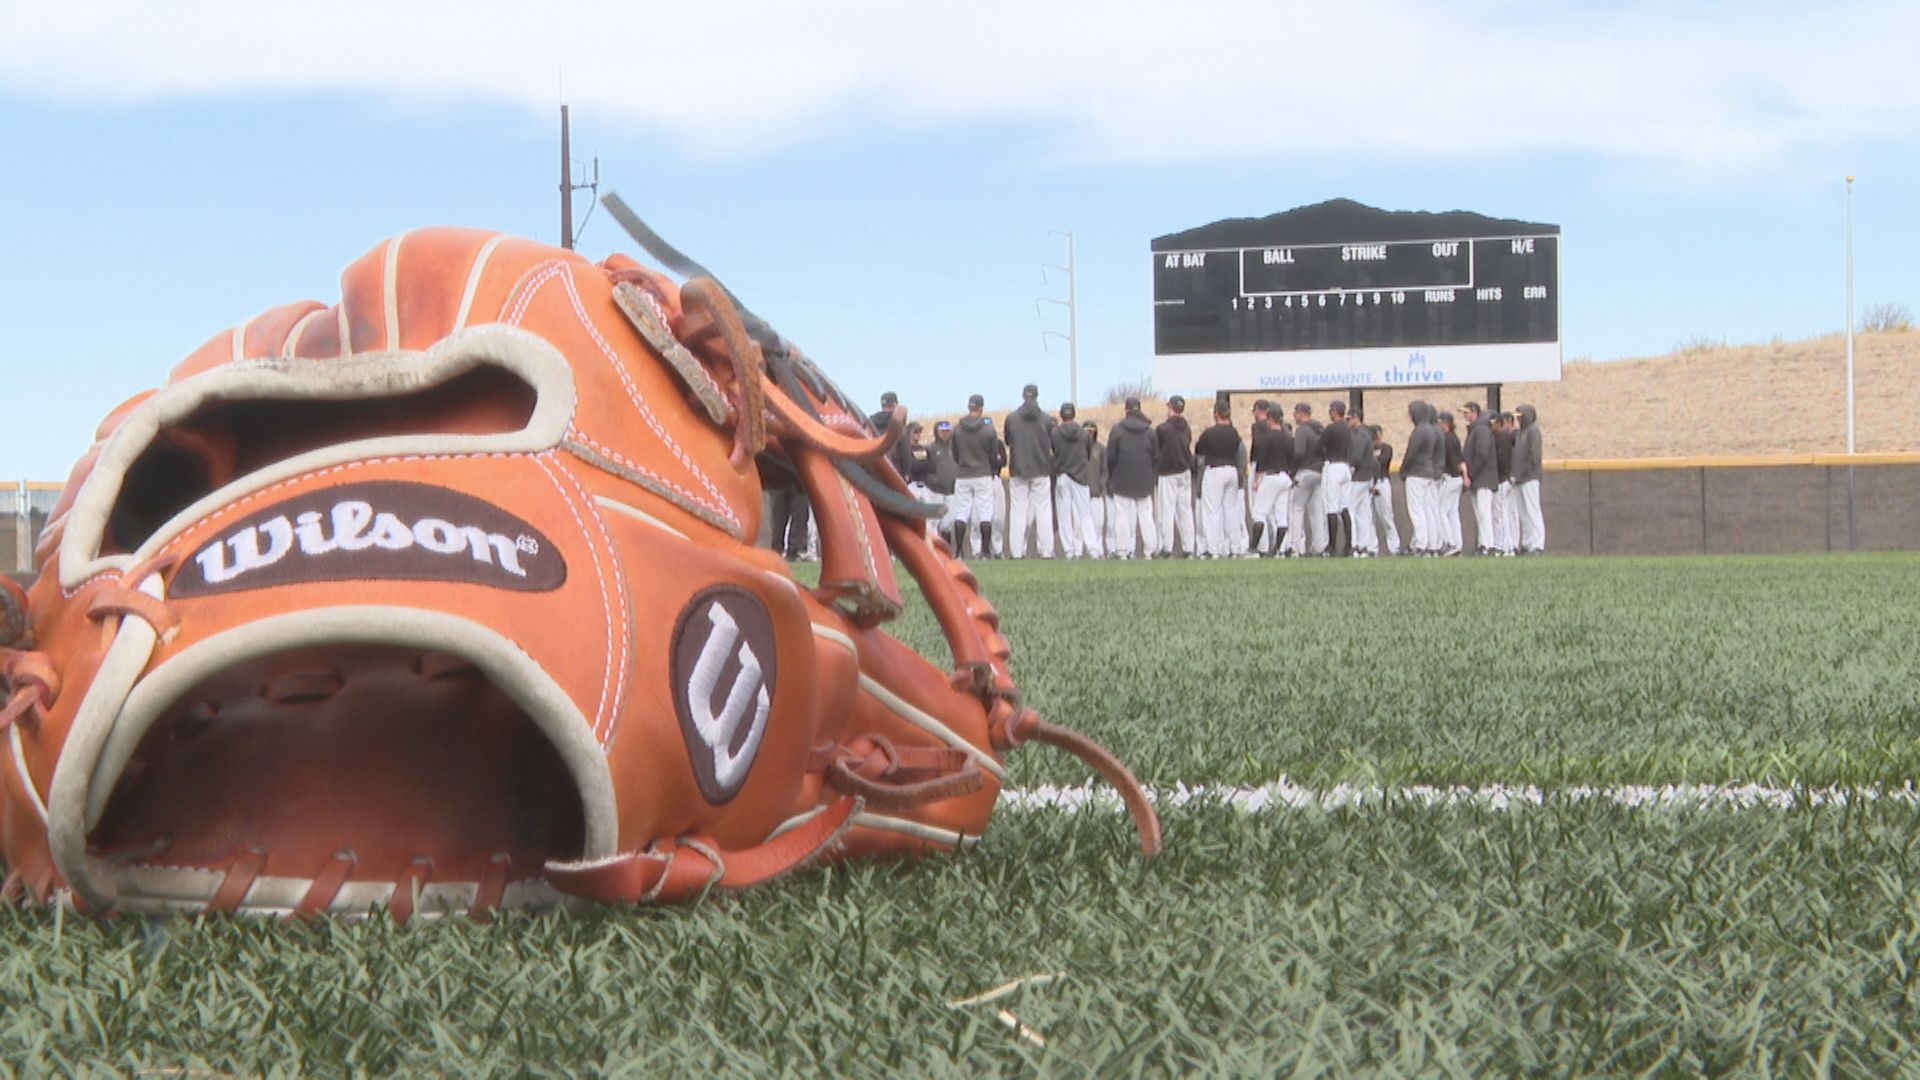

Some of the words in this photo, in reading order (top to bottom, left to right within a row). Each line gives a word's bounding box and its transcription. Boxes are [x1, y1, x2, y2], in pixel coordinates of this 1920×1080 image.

[1341, 244, 1387, 261] STRIKE
[1432, 242, 1459, 257] OUT
[1511, 239, 1535, 255] H/E
[1165, 254, 1181, 269] AT
[1183, 252, 1207, 268] BAT
[1263, 248, 1295, 265] BALL
[1232, 297, 1238, 310] 1
[1247, 297, 1255, 310] 2
[1264, 296, 1272, 309] 3
[1284, 295, 1292, 308] 4
[1301, 294, 1309, 307] 5
[1318, 294, 1326, 307] 6
[1339, 293, 1346, 306] 7
[1356, 292, 1363, 305] 8
[1373, 291, 1381, 305] 9
[1391, 291, 1405, 304] 10
[1424, 289, 1456, 303] RUNS
[1476, 287, 1503, 301] HITS
[1523, 285, 1546, 300] ERR
[1259, 374, 1296, 387] KAISER
[1385, 365, 1444, 383] thrive
[195, 500, 527, 583] Wilson
